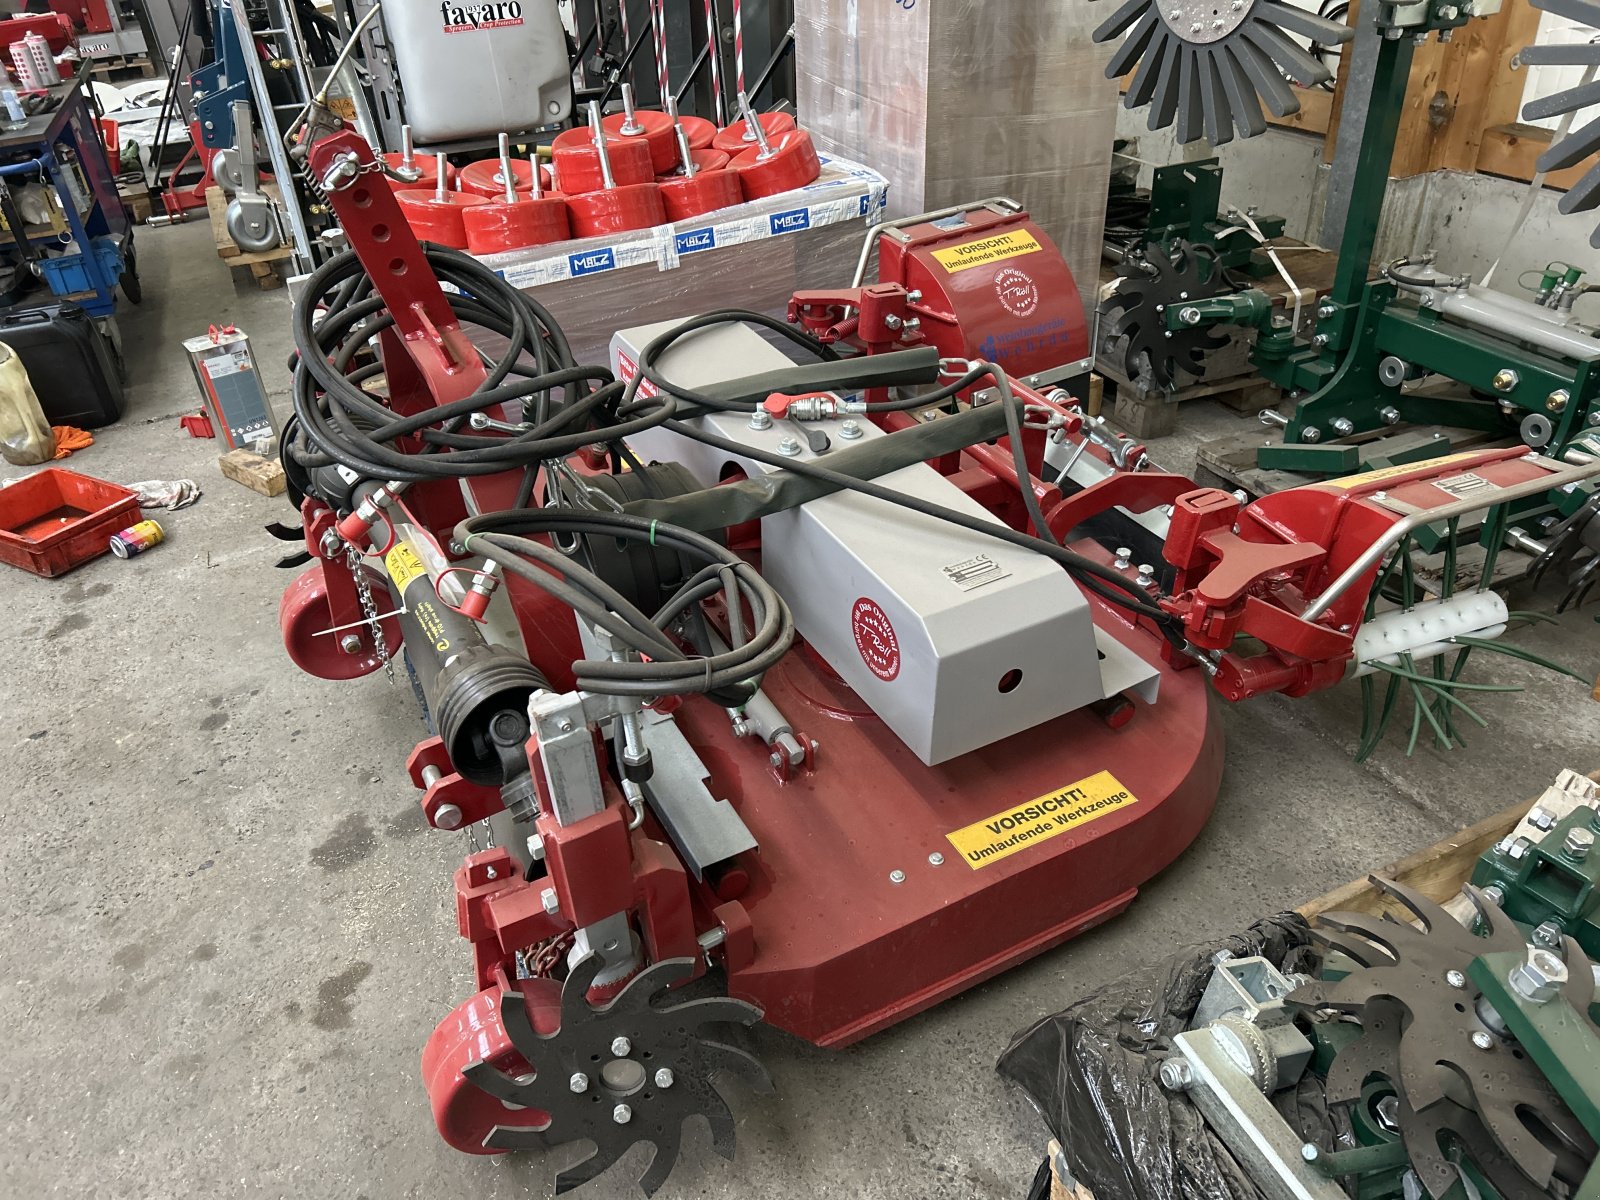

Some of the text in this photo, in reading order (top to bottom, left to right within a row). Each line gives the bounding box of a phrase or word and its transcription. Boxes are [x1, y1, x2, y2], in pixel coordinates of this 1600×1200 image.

[440, 1, 522, 29] favaro
[449, 24, 473, 32] Sprayers
[494, 19, 521, 27] Protection
[80, 43, 109, 53] avaro
[945, 241, 1038, 269] Umlaufende Werkzeuge
[954, 236, 1014, 256] VORSICHT!
[1004, 269, 1033, 284] Original
[858, 603, 898, 652] Das Original
[985, 787, 1088, 835] VORSICHT!
[967, 789, 1129, 862] Umlaufende Werkzeuge
